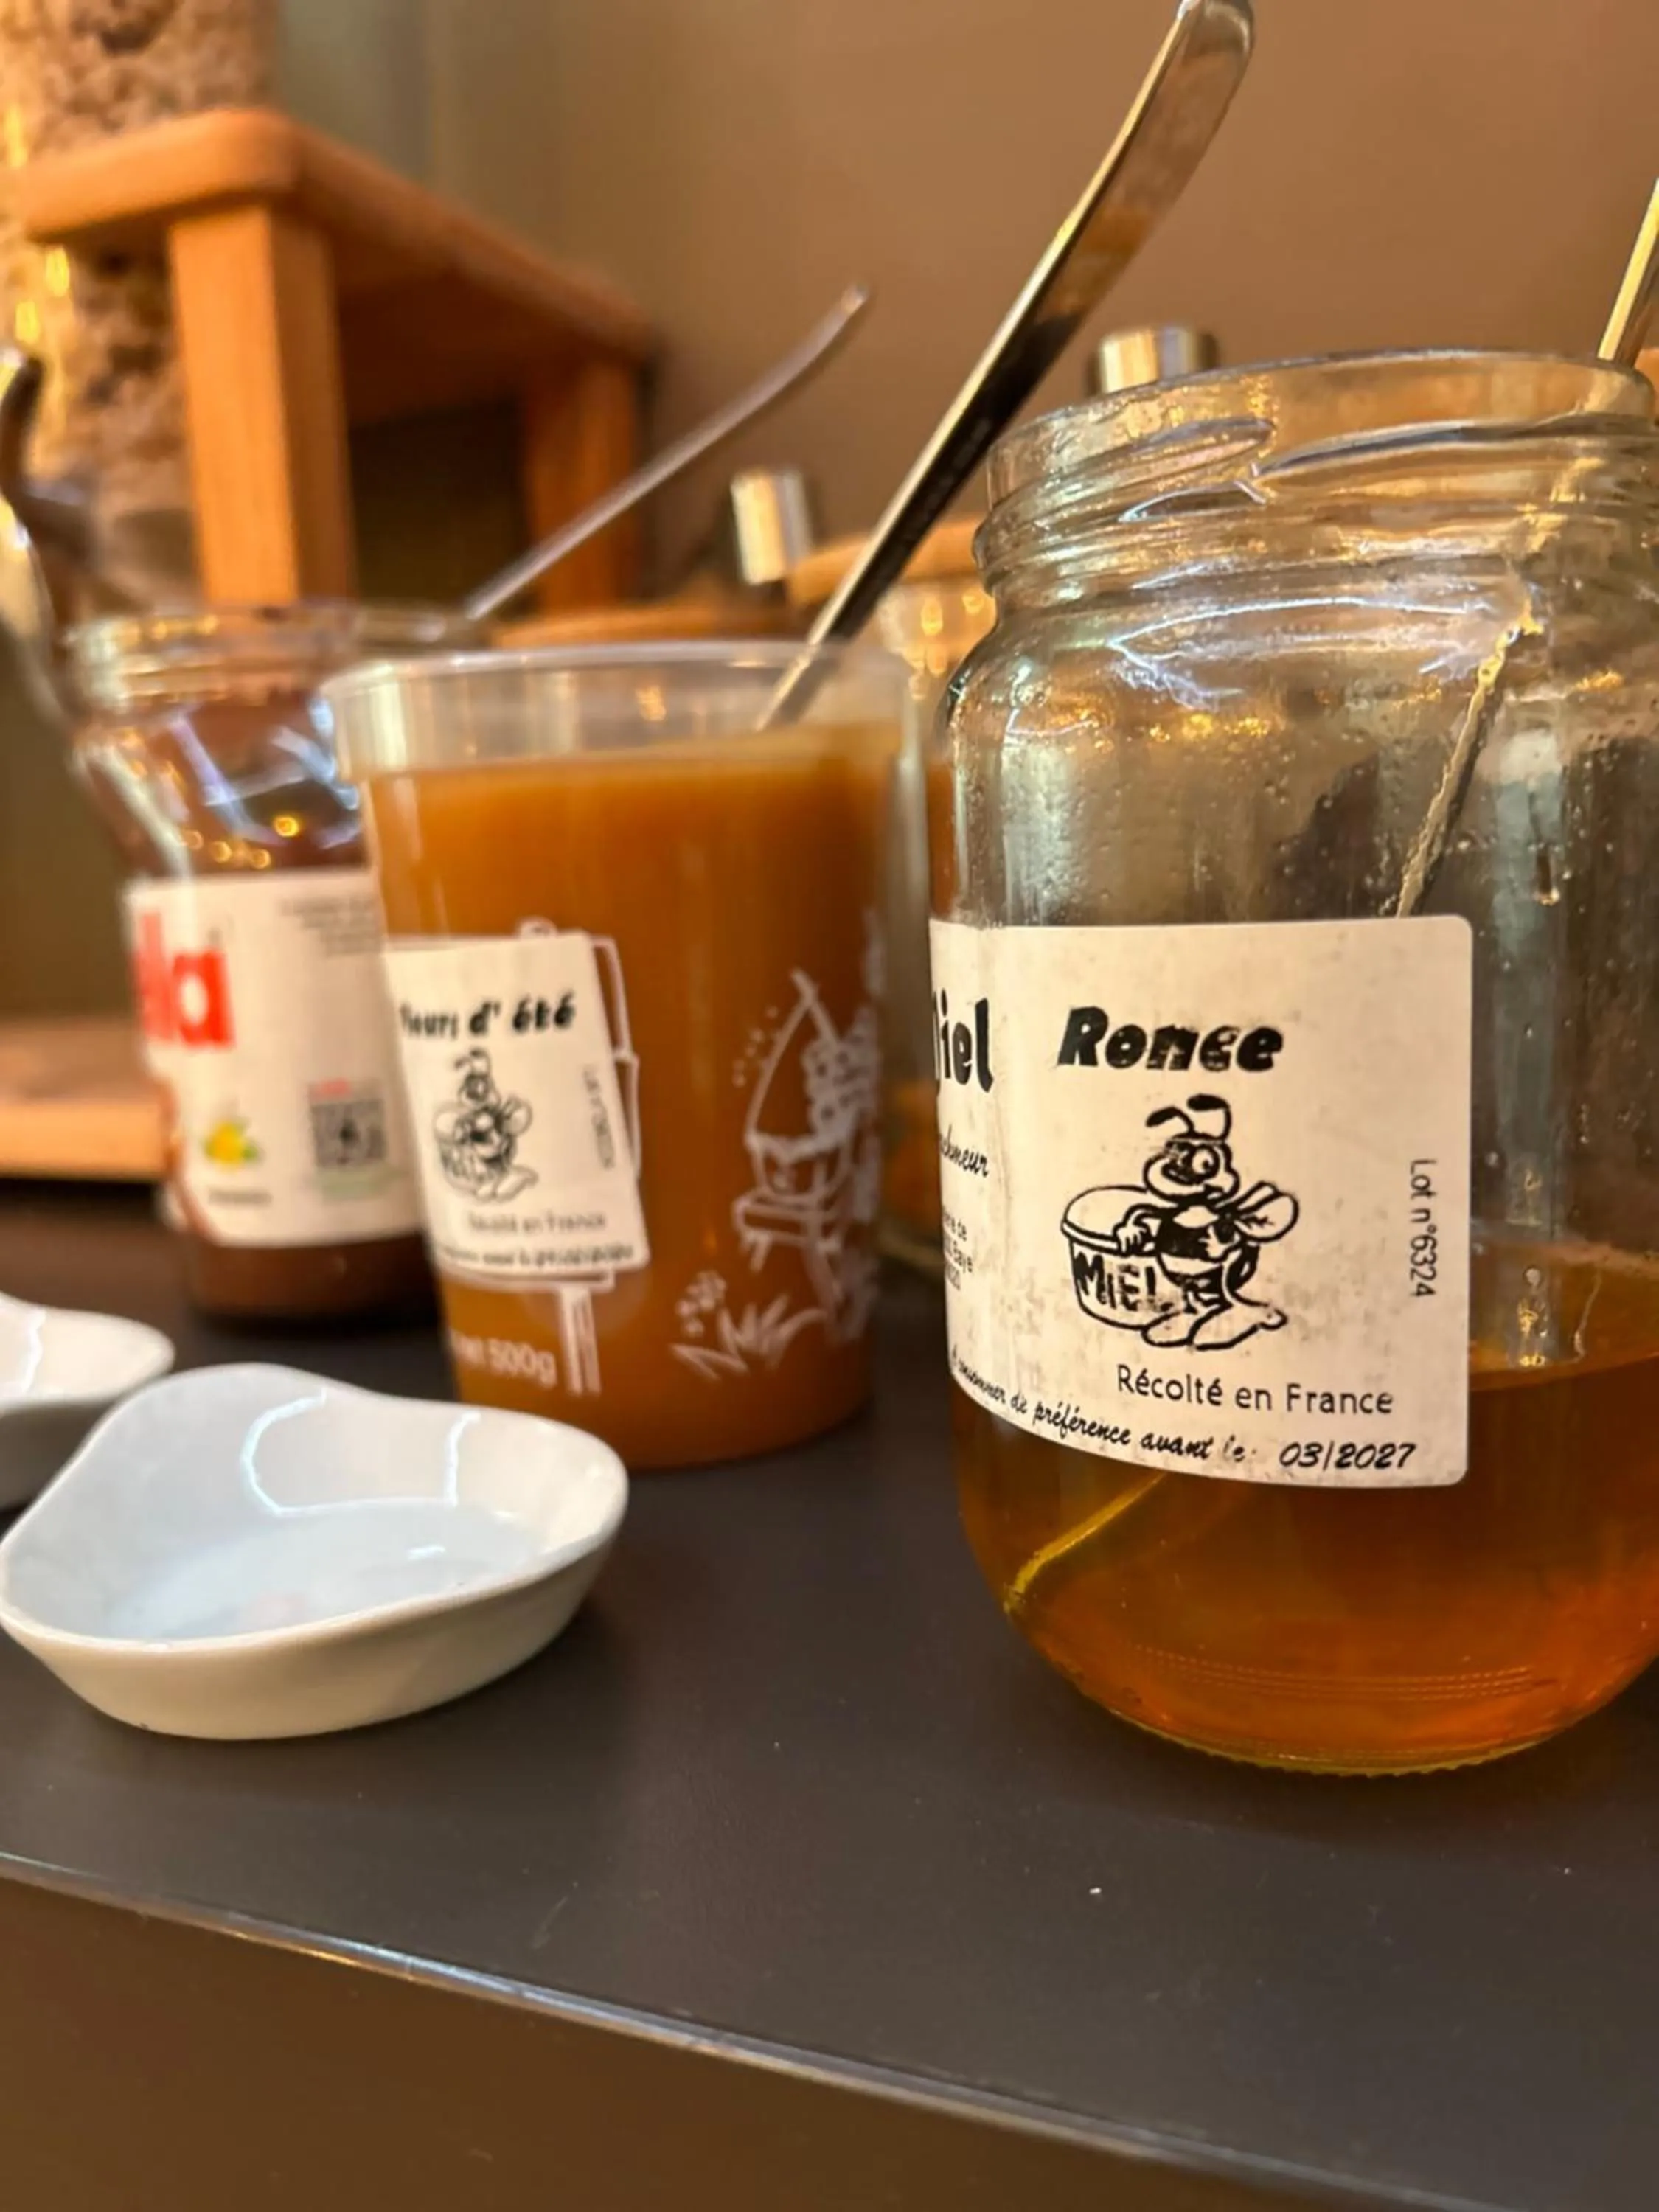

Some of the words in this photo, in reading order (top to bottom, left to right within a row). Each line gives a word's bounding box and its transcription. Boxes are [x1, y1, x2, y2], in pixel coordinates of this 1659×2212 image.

[934, 988, 994, 1093] iel
[1056, 1005, 1284, 1073] Ronce
[1409, 1159, 1438, 1202] Lot
[1409, 1207, 1439, 1298] n°6324
[1116, 1363, 1223, 1407] Récolté
[1234, 1385, 1273, 1411] en
[1286, 1382, 1394, 1415] France
[1032, 1400, 1132, 1447] préférence
[1140, 1428, 1214, 1460] avant
[1278, 1439, 1417, 1472] 03/2027
